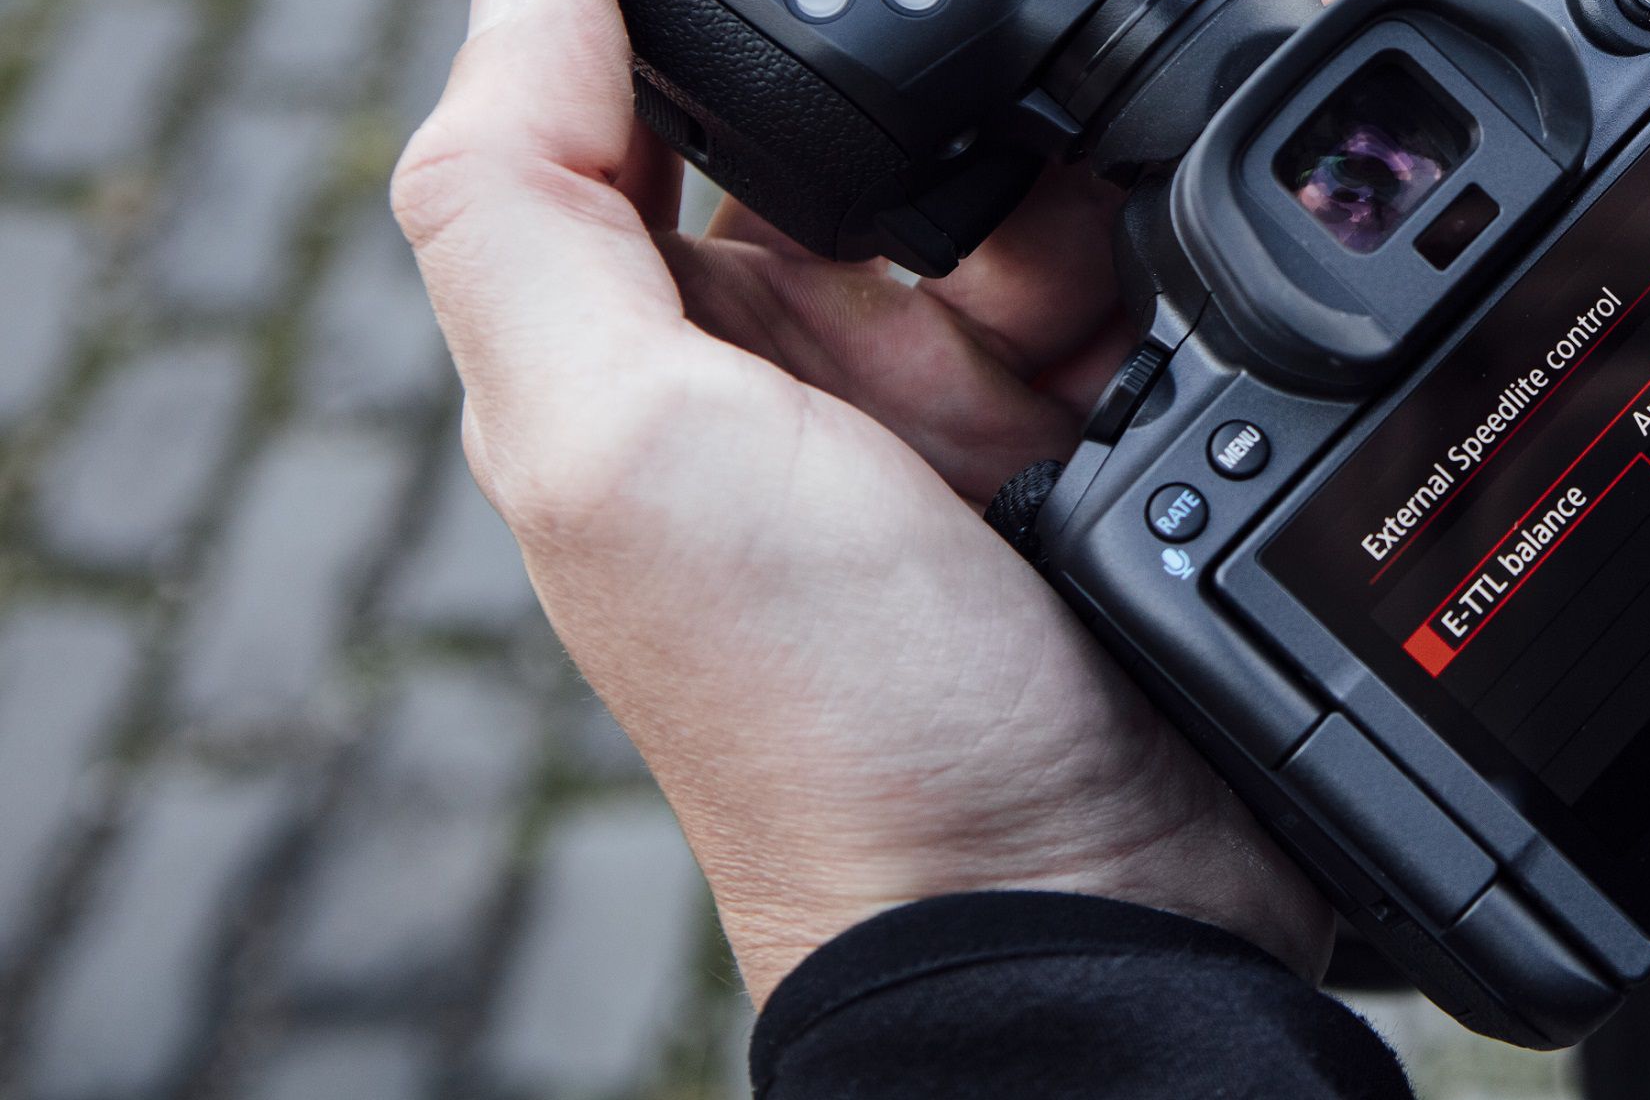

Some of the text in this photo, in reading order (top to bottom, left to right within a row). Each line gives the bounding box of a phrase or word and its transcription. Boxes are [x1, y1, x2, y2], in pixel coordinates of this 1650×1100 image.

[1216, 425, 1260, 469] MENU
[1360, 286, 1623, 562] External Speedlite control
[1155, 490, 1200, 534] RATE
[1441, 485, 1588, 639] E-TTL balance
